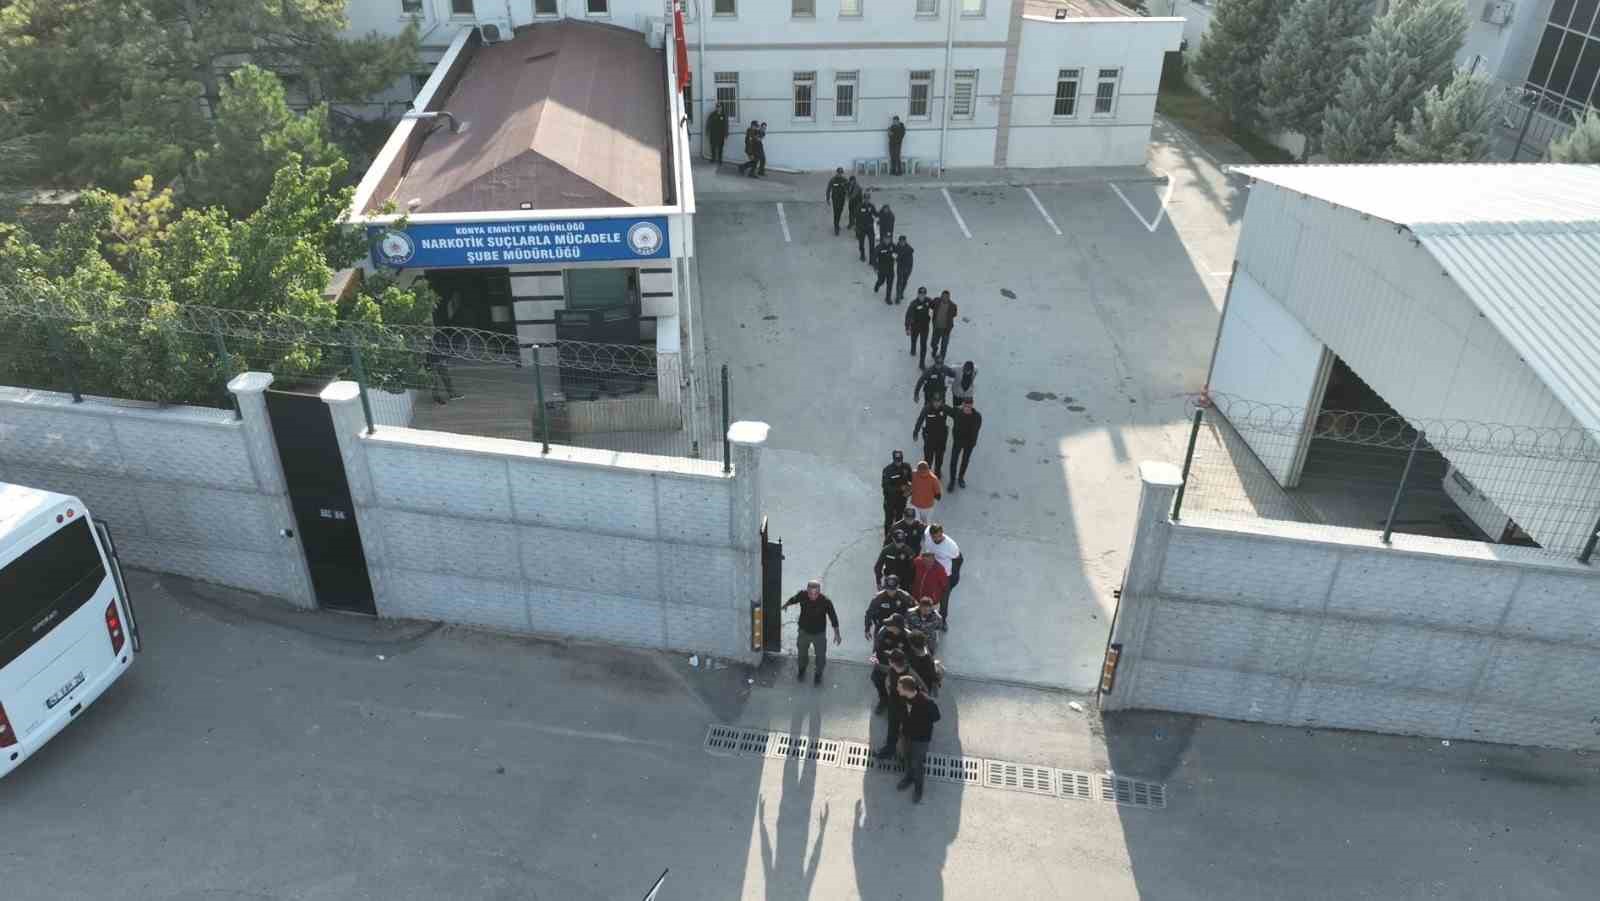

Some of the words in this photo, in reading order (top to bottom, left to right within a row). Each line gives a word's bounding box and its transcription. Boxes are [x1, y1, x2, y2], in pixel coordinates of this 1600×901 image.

[455, 226, 486, 235] KONYA
[421, 236, 485, 249] NARKOTİK
[487, 235, 551, 249] SUÇLARLA
[554, 232, 621, 245] MÜCADELE
[466, 251, 499, 264] ŞUBE
[503, 246, 580, 260] MÜDÜRLÜĞÜ
